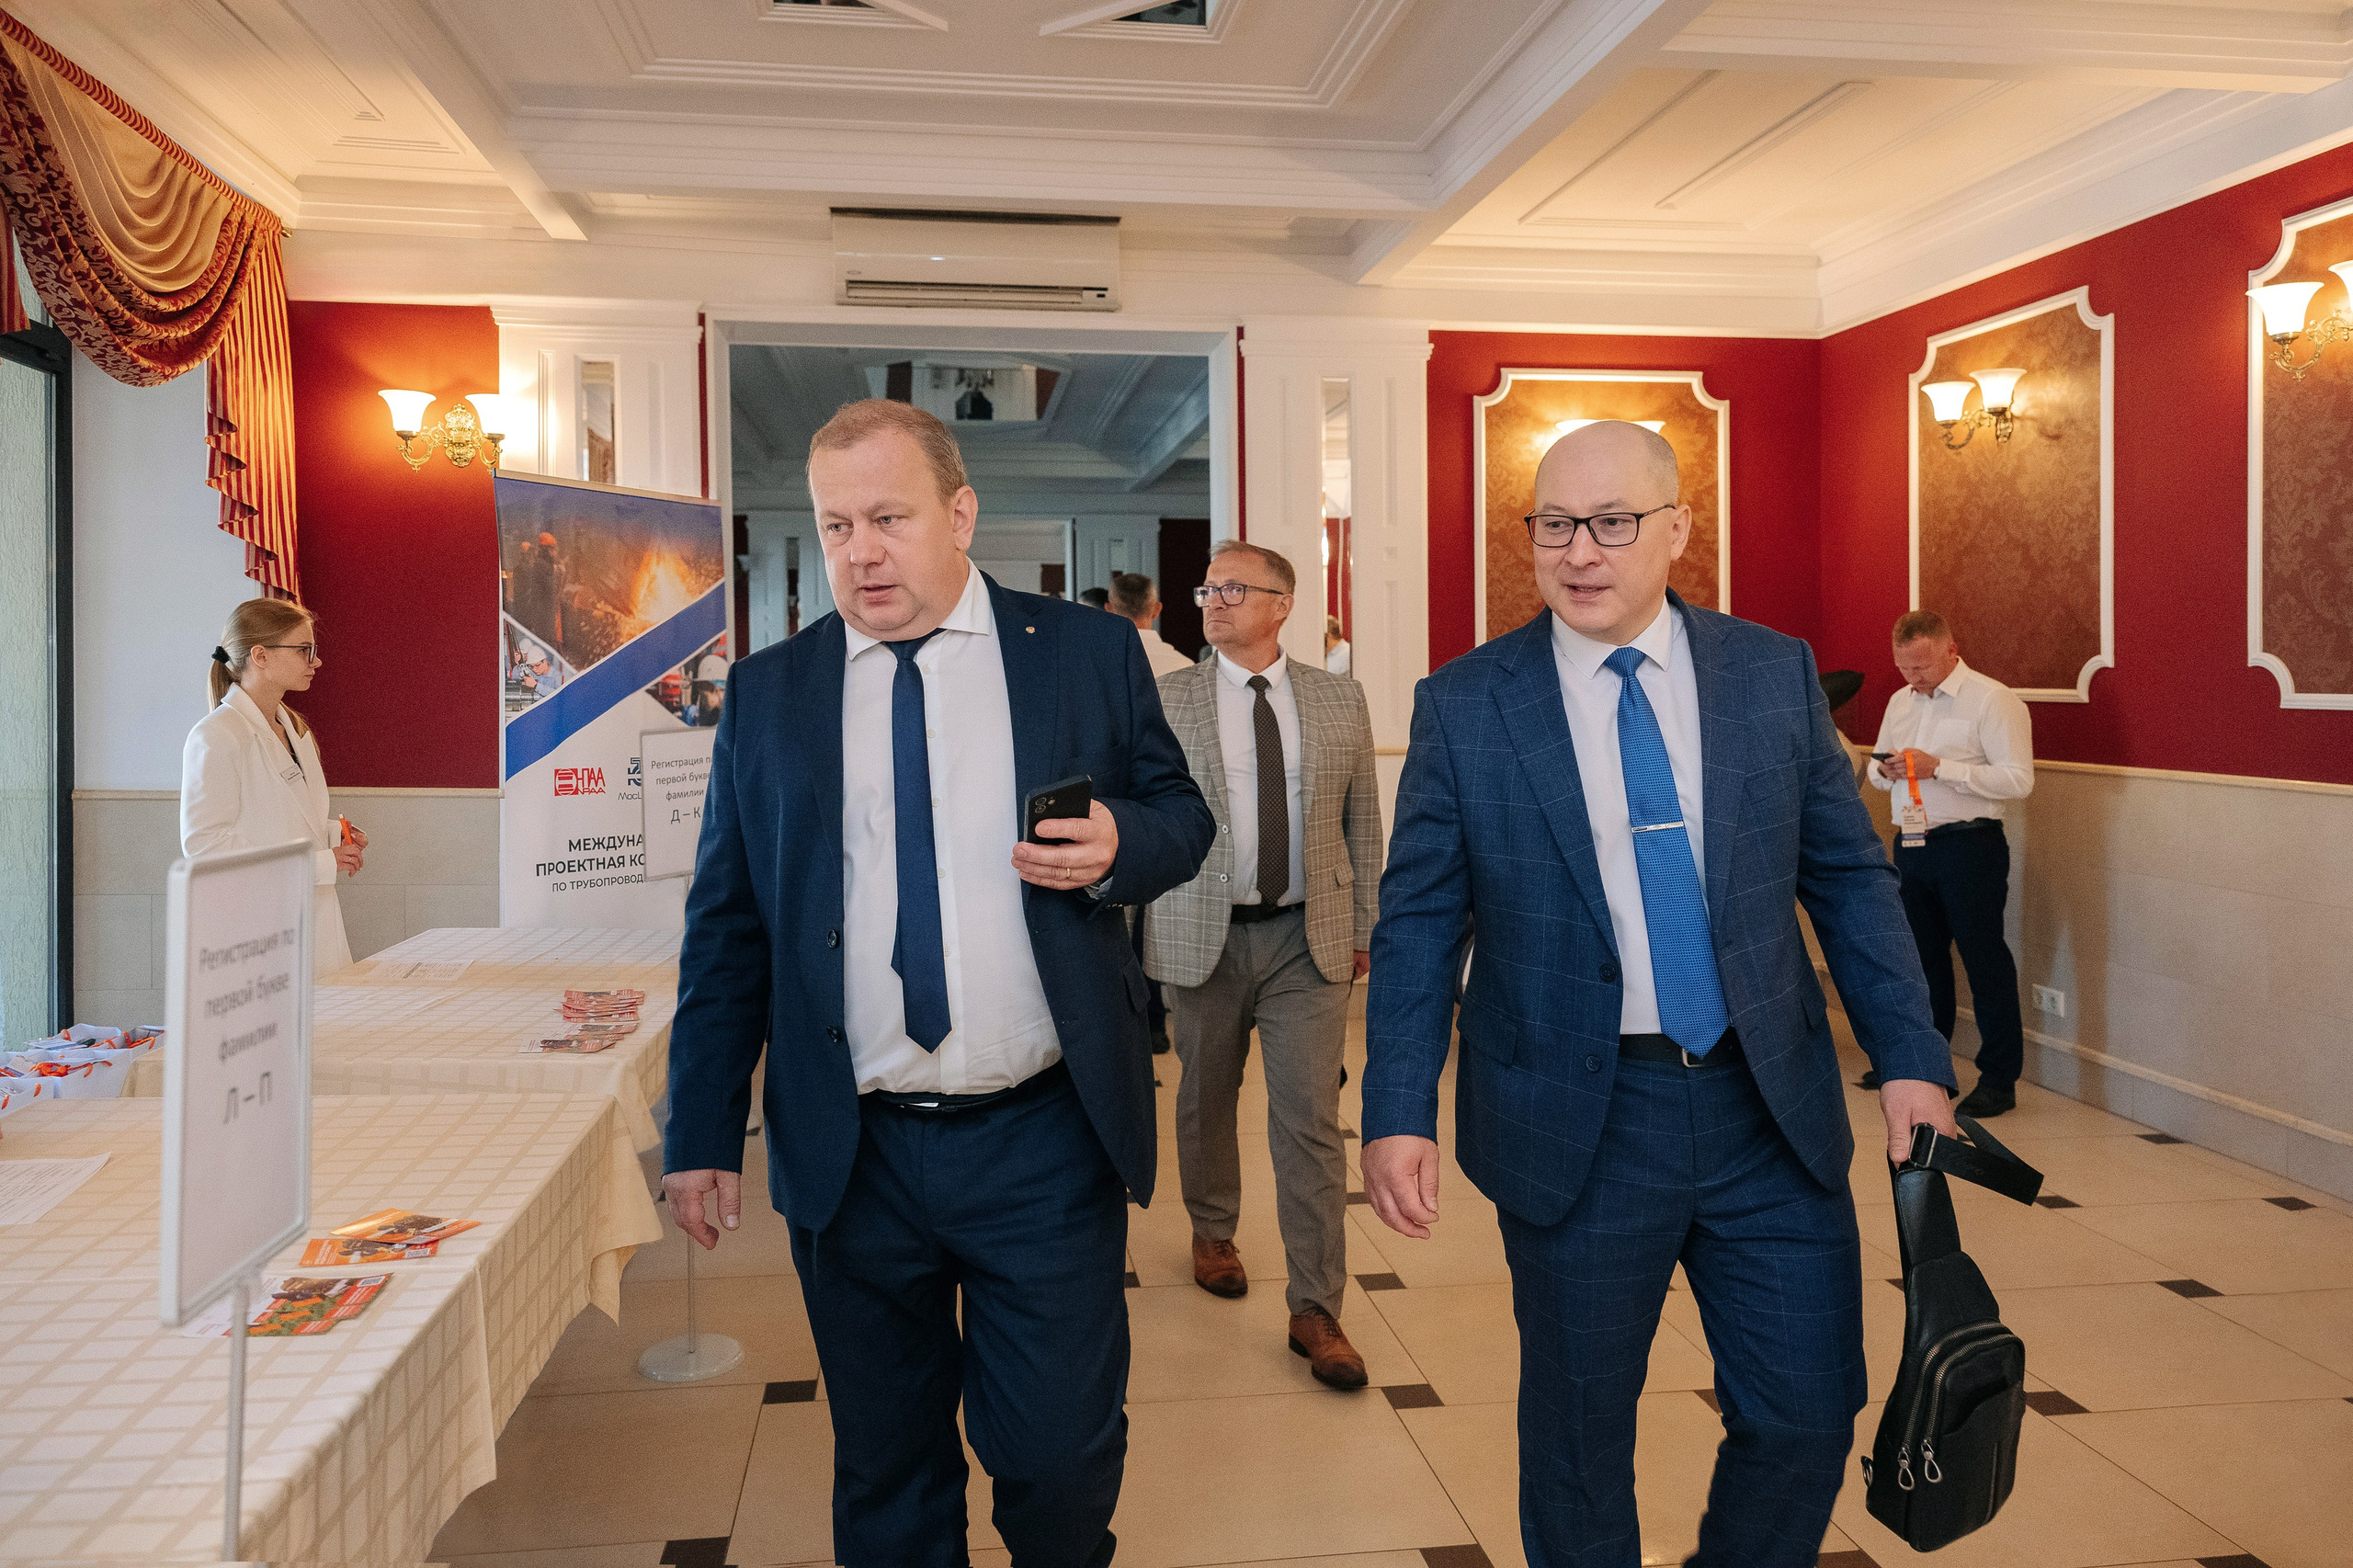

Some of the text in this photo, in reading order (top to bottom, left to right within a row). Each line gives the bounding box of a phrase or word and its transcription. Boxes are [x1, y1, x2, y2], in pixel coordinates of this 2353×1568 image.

[651, 757, 704, 769] Регистрация
[655, 773, 688, 786] первой
[665, 790, 704, 801] фамилии
[670, 809, 681, 824] Д
[693, 806, 701, 818] К
[568, 834, 643, 852] МЕЖДУНА
[536, 855, 626, 877] ПРОЕКТНАЯ
[552, 873, 643, 892] ПО ТРУБОПРОВОД
